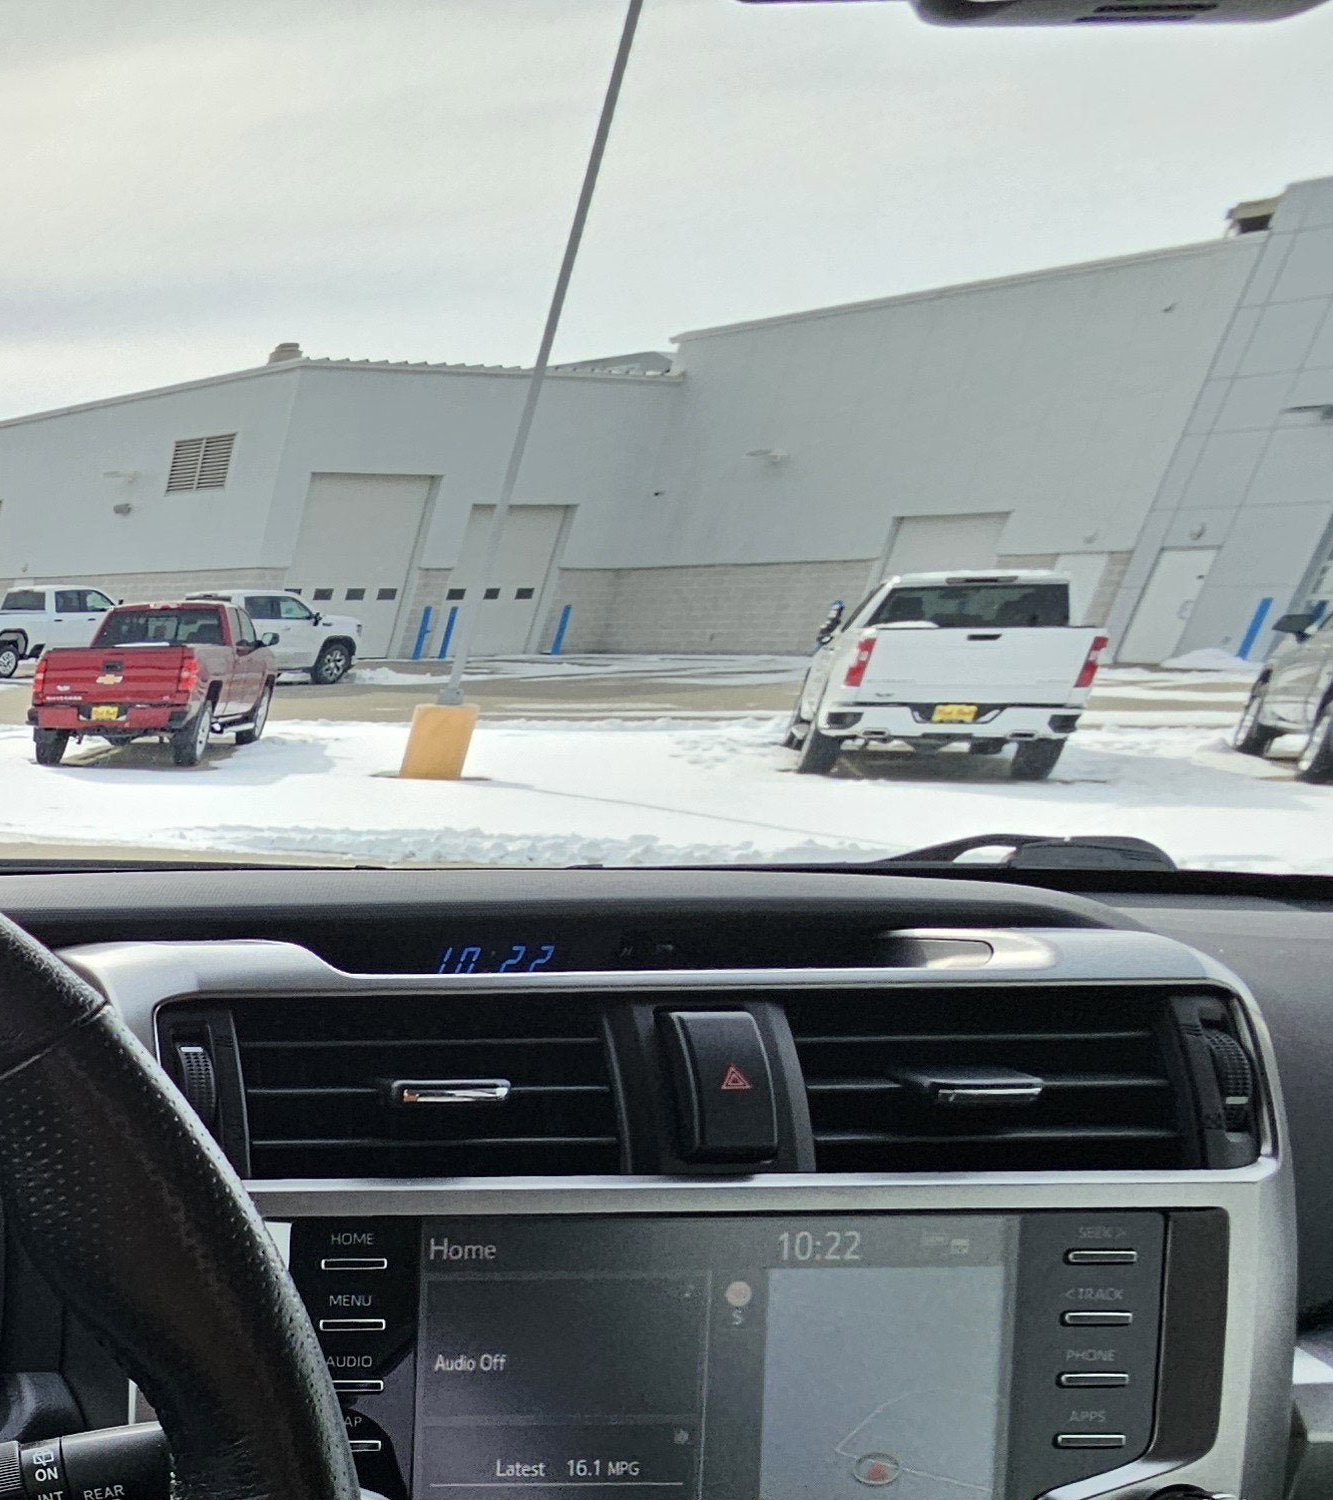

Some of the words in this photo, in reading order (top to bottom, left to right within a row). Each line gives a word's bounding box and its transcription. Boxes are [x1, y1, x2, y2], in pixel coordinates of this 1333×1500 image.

[331, 1232, 375, 1245] HOME
[429, 1237, 497, 1261] Home
[777, 1231, 861, 1261] 10:22
[329, 1294, 373, 1307] MENU
[326, 1355, 373, 1368] AUDIO
[434, 1353, 476, 1371] Audio
[480, 1352, 507, 1371] Off
[1066, 1348, 1116, 1362] PHONE
[342, 1416, 363, 1428] AP
[1069, 1409, 1106, 1423] APPS
[34, 1466, 59, 1483] ON
[495, 1458, 547, 1478] Latest
[566, 1457, 602, 1477] 16.1
[607, 1460, 641, 1477] MPG
